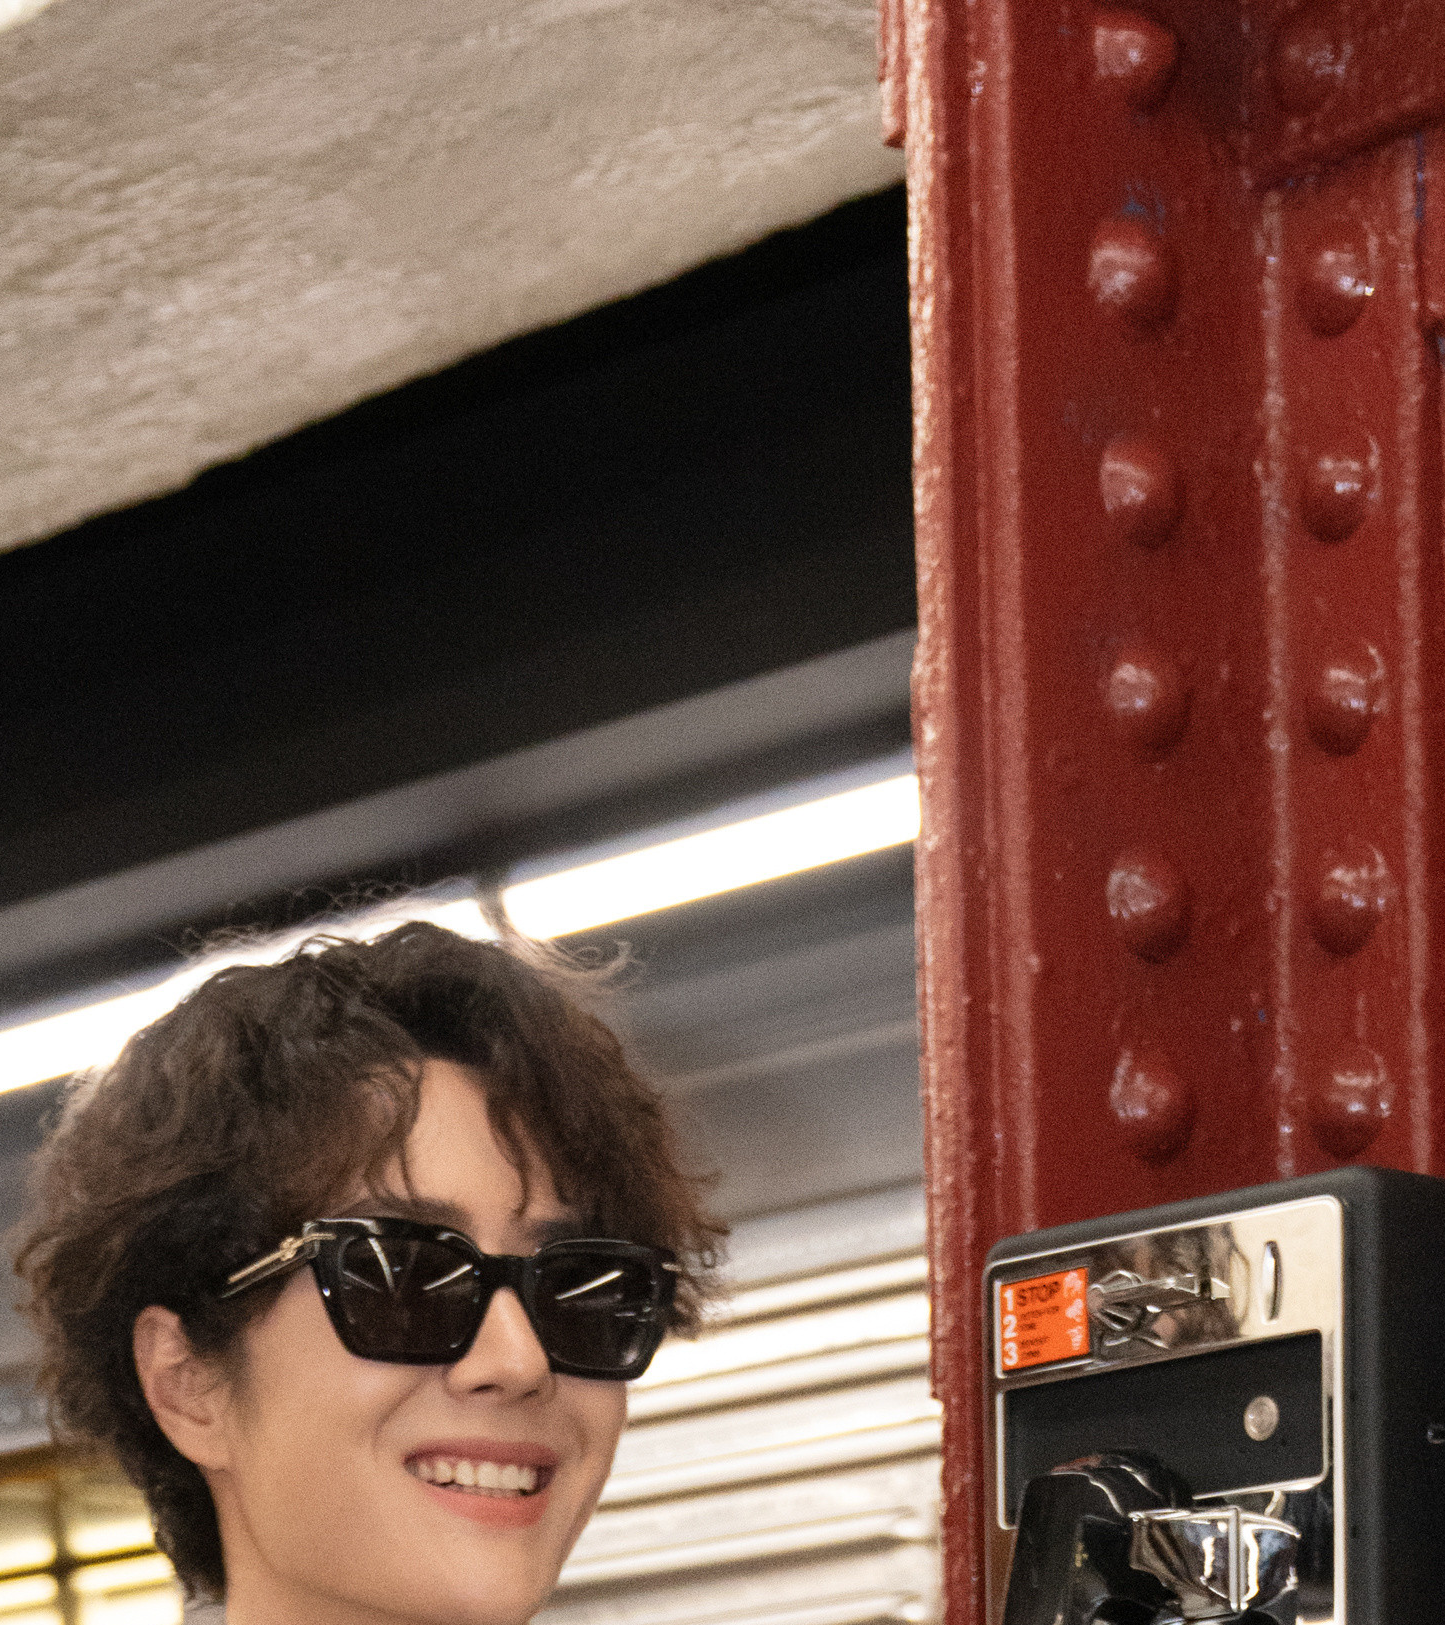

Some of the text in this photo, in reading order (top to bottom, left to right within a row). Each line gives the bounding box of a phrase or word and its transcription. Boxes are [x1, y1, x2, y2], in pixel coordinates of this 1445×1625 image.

[1004, 1281, 1061, 1311] 1 STOP
[1003, 1314, 1018, 1339] 2
[1003, 1341, 1018, 1366] 3
